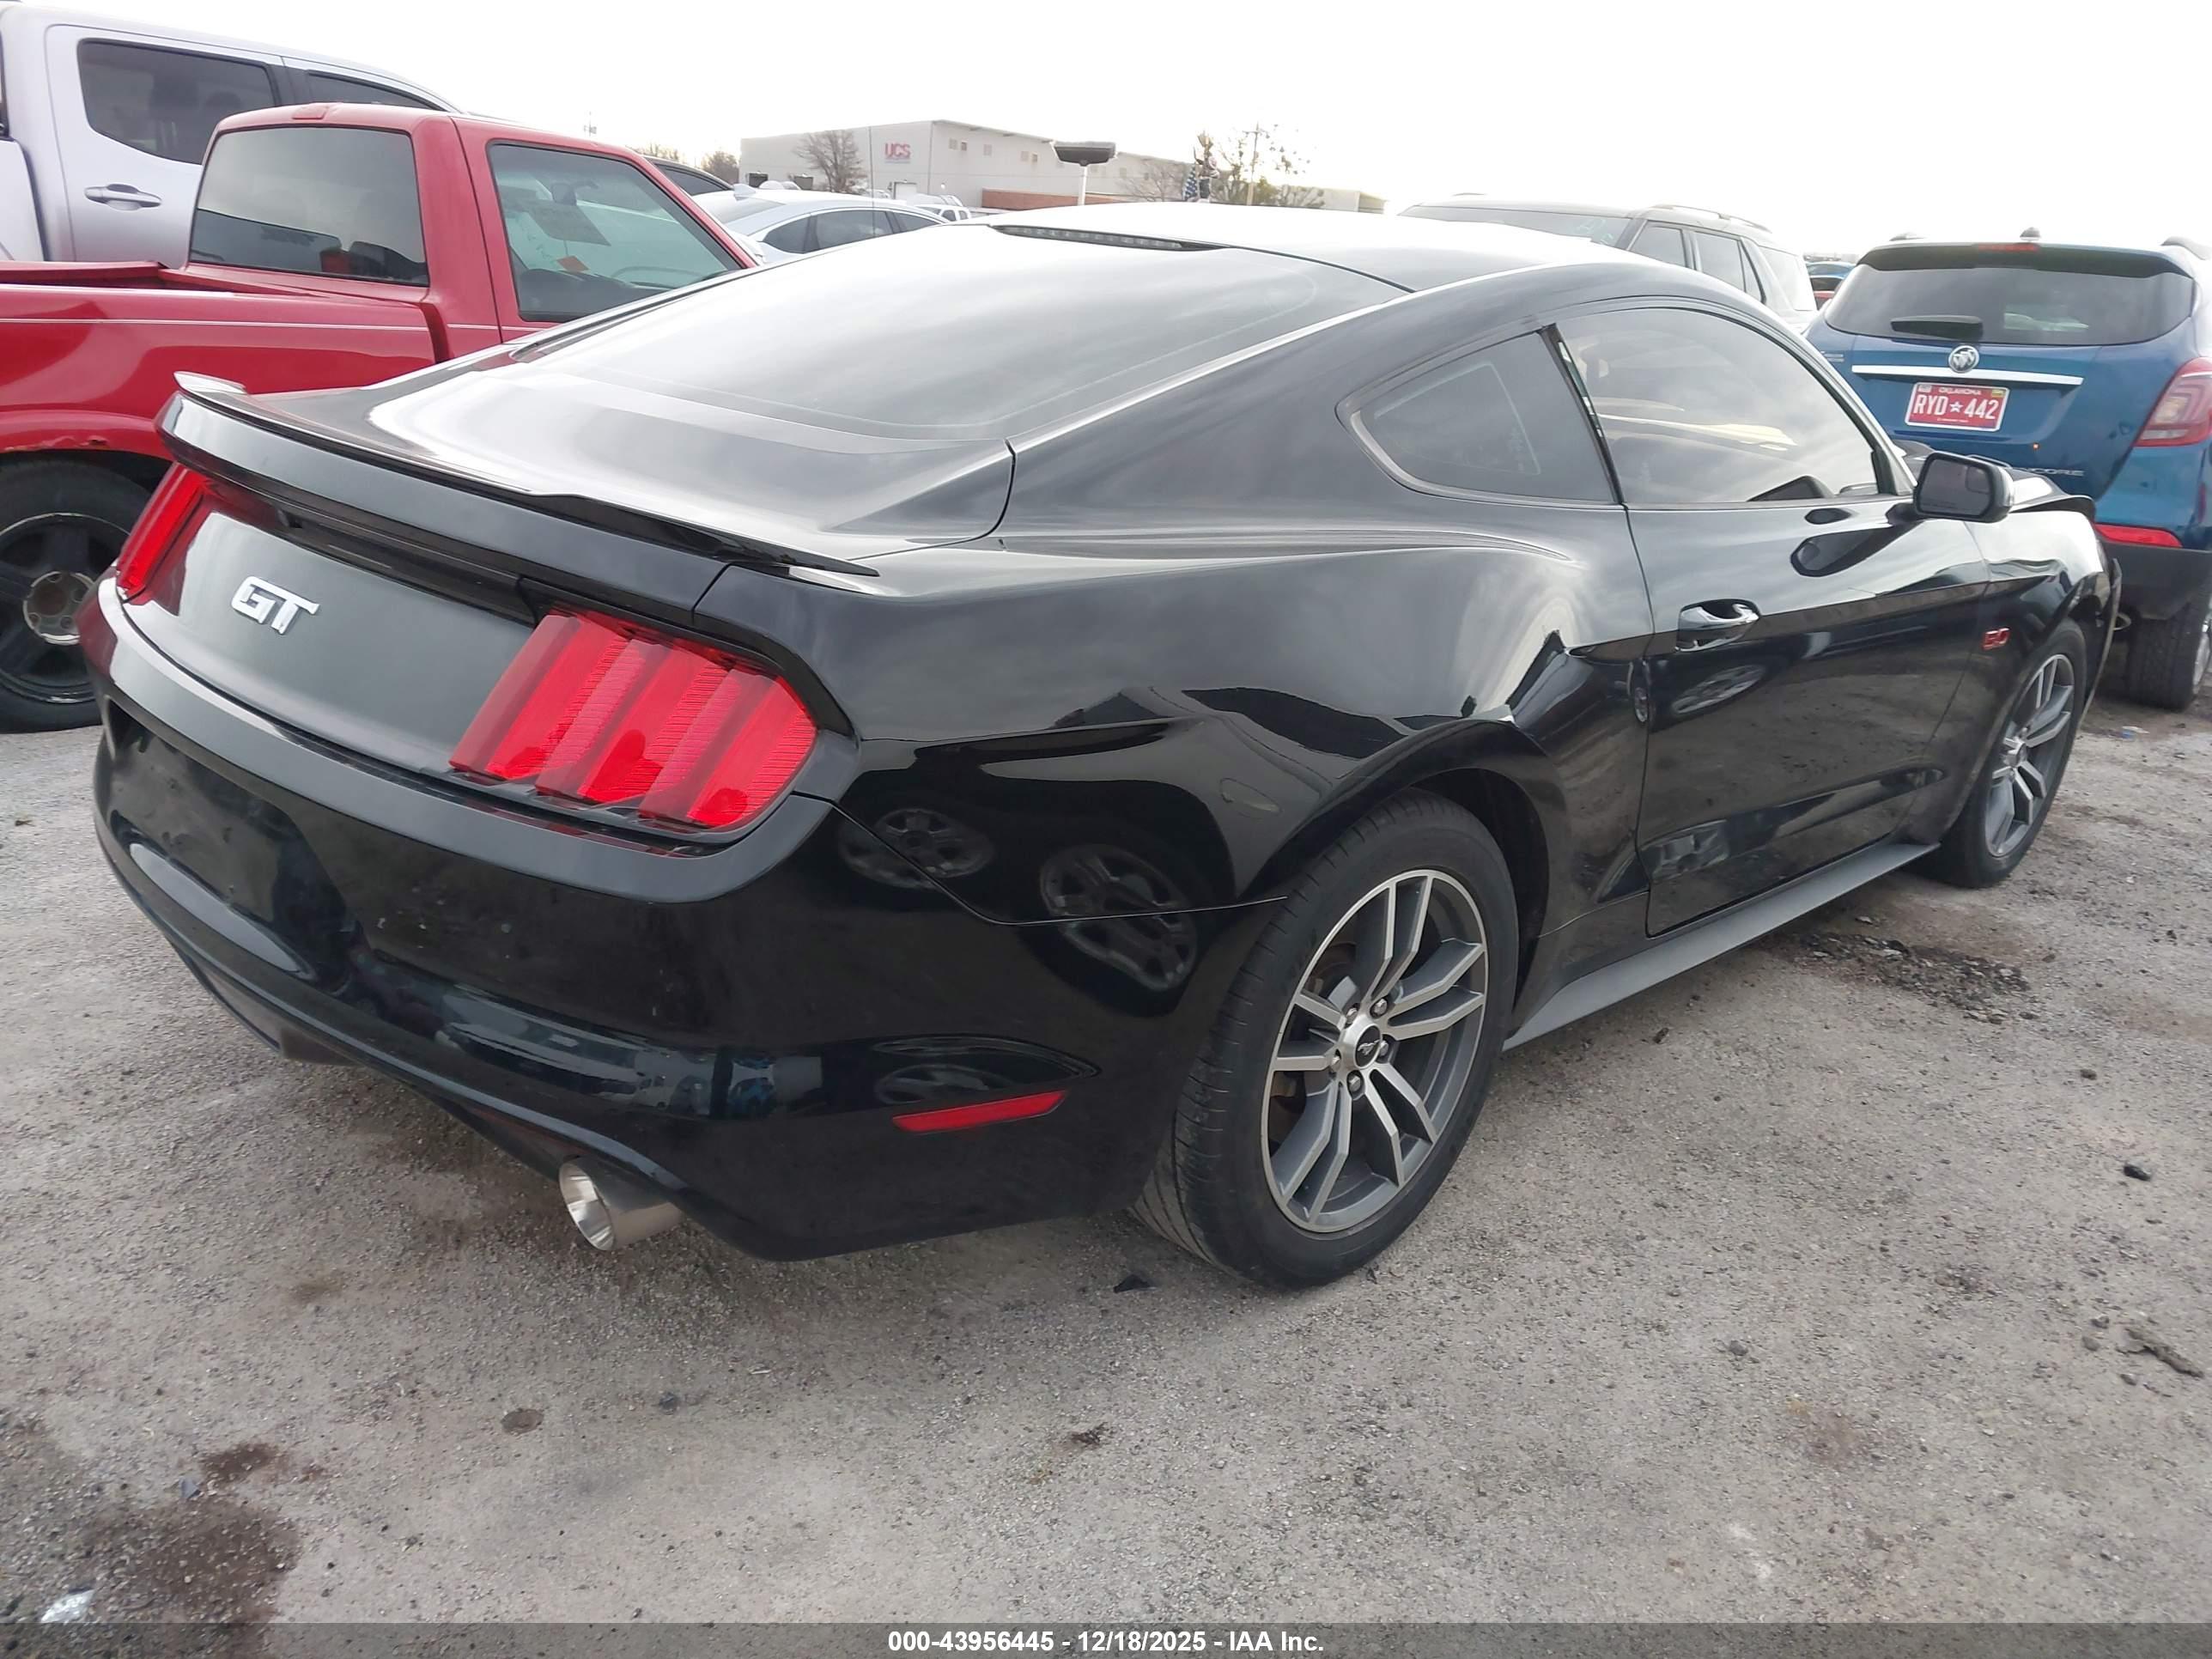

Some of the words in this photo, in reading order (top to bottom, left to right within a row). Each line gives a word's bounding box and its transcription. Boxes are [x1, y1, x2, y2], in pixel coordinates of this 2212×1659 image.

[884, 143, 911, 158] UCS
[1912, 394, 1948, 416] RYD
[1964, 398, 1999, 419] 442
[231, 575, 321, 635] GT
